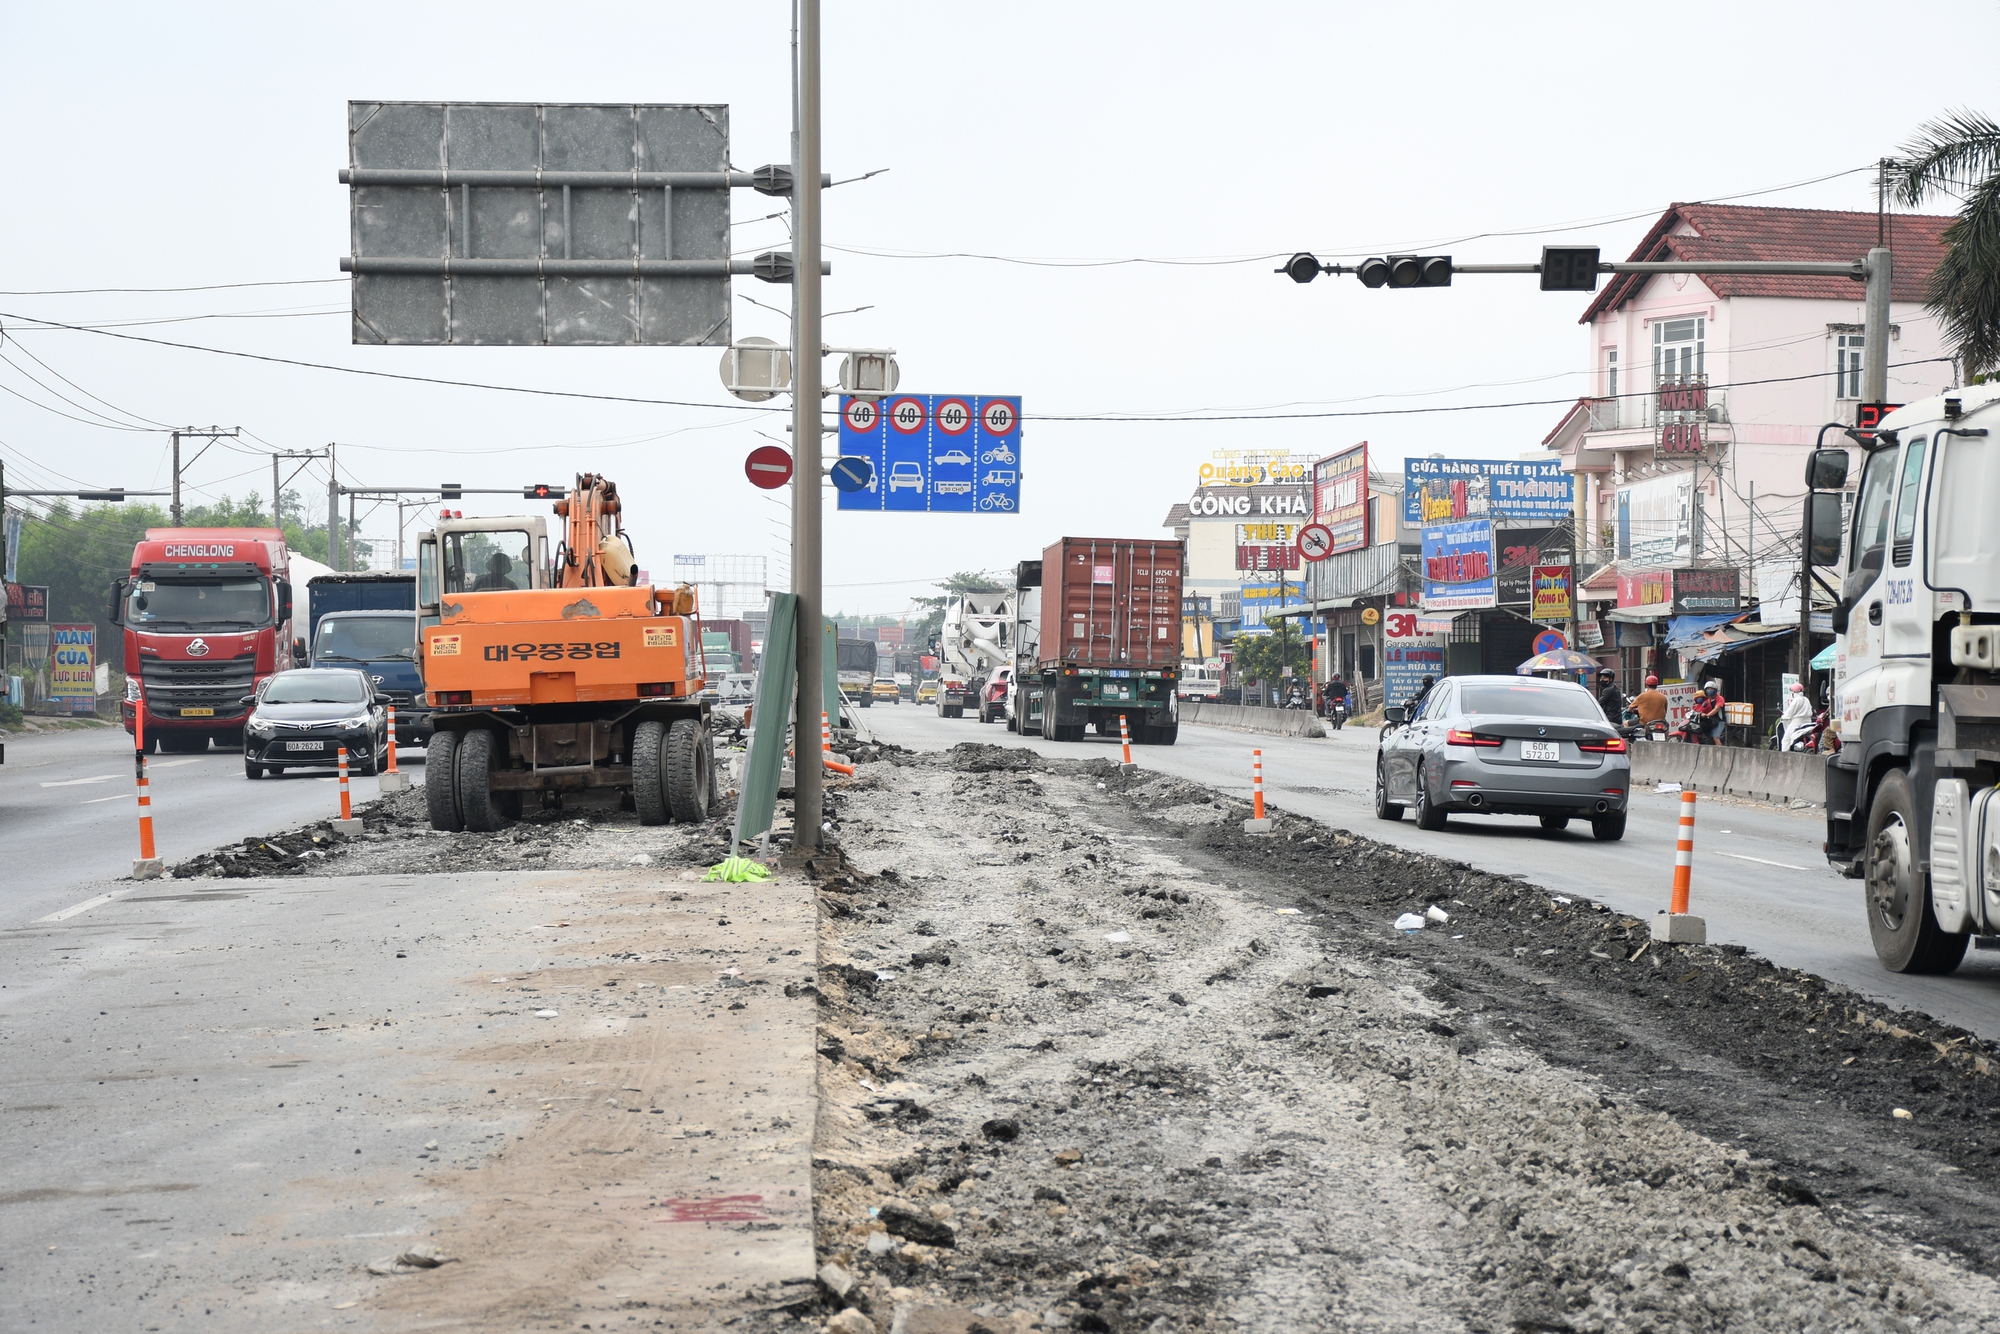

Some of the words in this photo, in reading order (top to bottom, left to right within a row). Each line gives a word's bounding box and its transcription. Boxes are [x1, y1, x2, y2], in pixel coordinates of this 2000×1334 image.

[1660, 376, 1705, 411] MÀN
[854, 407, 870, 422] 60
[899, 407, 915, 423] 60
[945, 408, 961, 424] 60
[991, 410, 1007, 425] 60
[1411, 460, 1438, 473] CỬA
[1482, 463, 1520, 476] THIẾT
[1523, 465, 1536, 477] BỊ
[1497, 478, 1567, 499] THÀNH
[1189, 491, 1251, 515] CÔNG
[165, 545, 234, 557] CHENGLONG
[1503, 546, 1539, 567] 3M
[1678, 572, 1735, 593] MASSAGE
[1537, 592, 1556, 604] CÔNG
[1557, 591, 1566, 604] LÝ
[54, 627, 93, 646] MÀN
[484, 641, 620, 662] 대우중공업
[1386, 640, 1415, 650] Garage
[1417, 640, 1437, 648] Auto
[56, 647, 89, 665] CỬA
[1386, 649, 1402, 662] LÊ
[1406, 650, 1443, 663] HƯNG
[1407, 661, 1427, 671] RỬA
[1429, 663, 1442, 671] XE
[53, 670, 70, 685] LỰC
[73, 669, 92, 682] LIÊN
[1670, 687, 1679, 695] BÒ
[1532, 742, 1549, 751] 60K
[1525, 750, 1556, 760] 572.07
